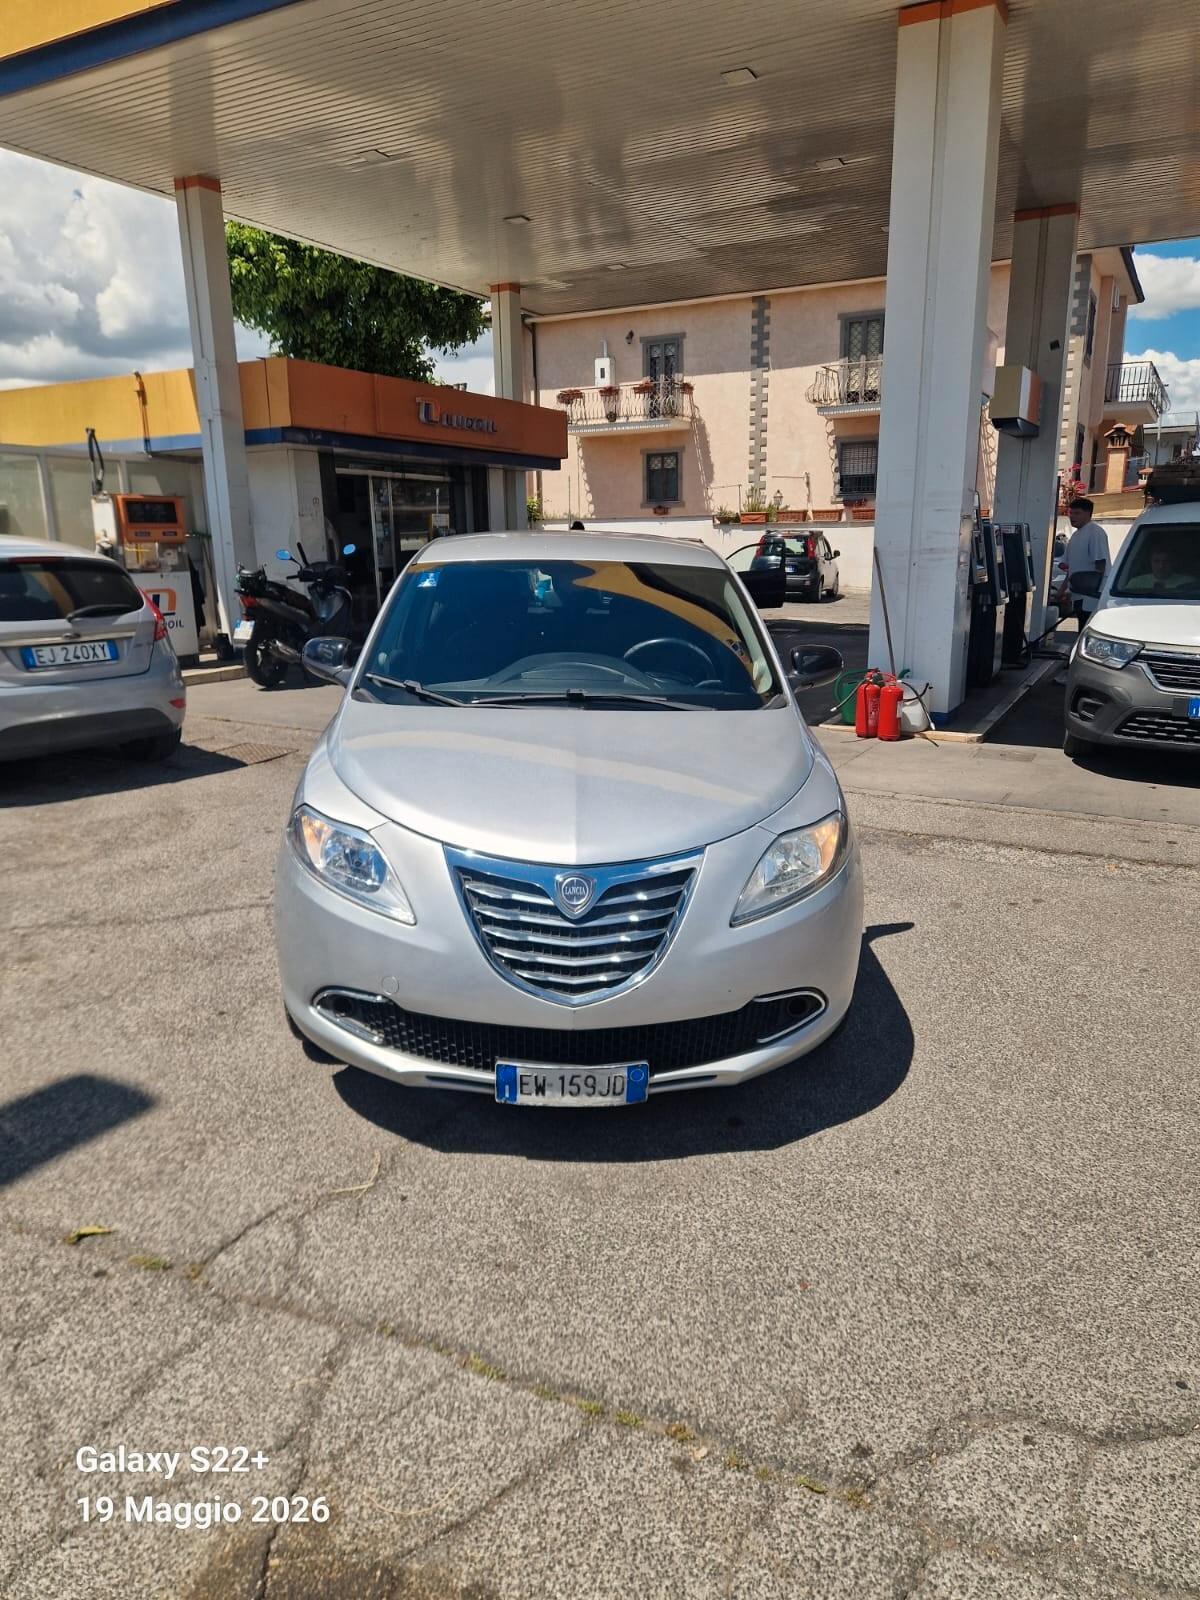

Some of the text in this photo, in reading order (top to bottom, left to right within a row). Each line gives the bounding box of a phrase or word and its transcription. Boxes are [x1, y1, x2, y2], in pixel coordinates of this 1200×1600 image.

[35, 647, 56, 664] EJ
[61, 642, 108, 662] 240XY
[565, 886, 586, 895] LANCIA
[519, 1074, 625, 1097] EW 159JD
